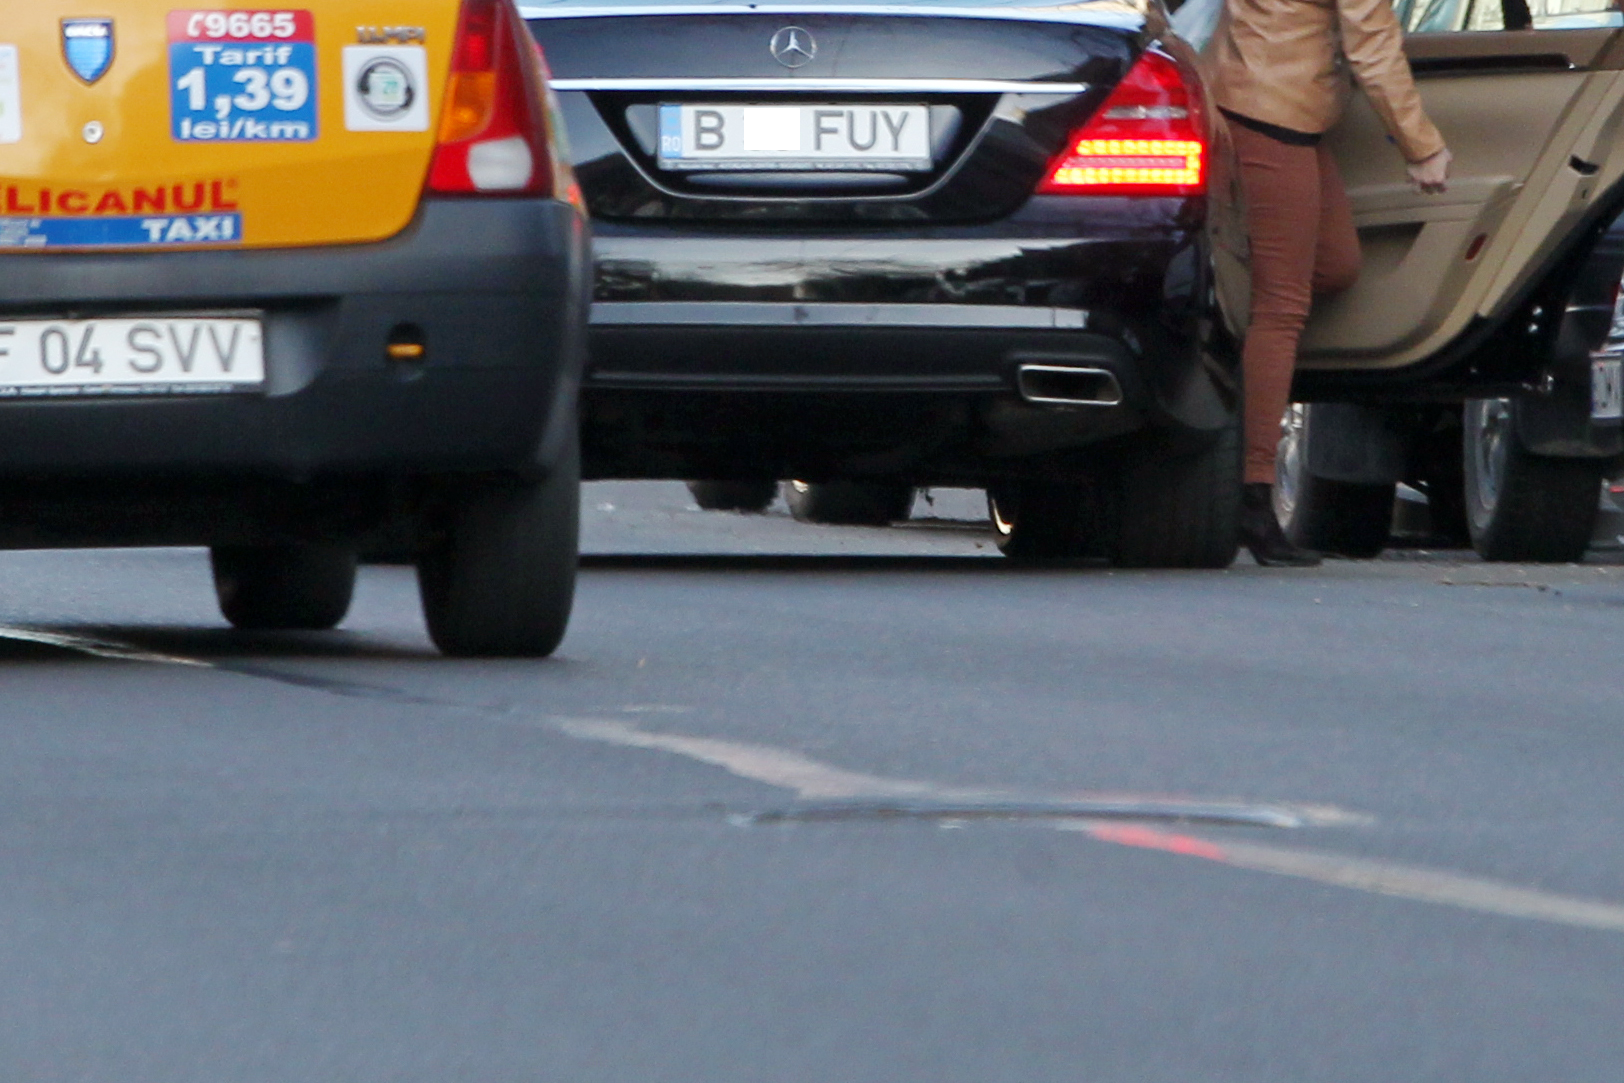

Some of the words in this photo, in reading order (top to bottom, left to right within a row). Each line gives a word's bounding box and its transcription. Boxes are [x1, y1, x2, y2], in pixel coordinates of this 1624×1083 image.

[204, 12, 296, 38] 9665
[193, 45, 293, 65] Tarif
[177, 67, 309, 119] 1,39
[180, 118, 309, 139] lei/km
[662, 135, 681, 152] RO
[695, 110, 725, 151] B
[813, 110, 909, 151] FUY
[0, 180, 238, 213] LICANUL
[141, 217, 235, 243] TAXI
[39, 324, 103, 374] 04
[127, 322, 242, 374] SVV
